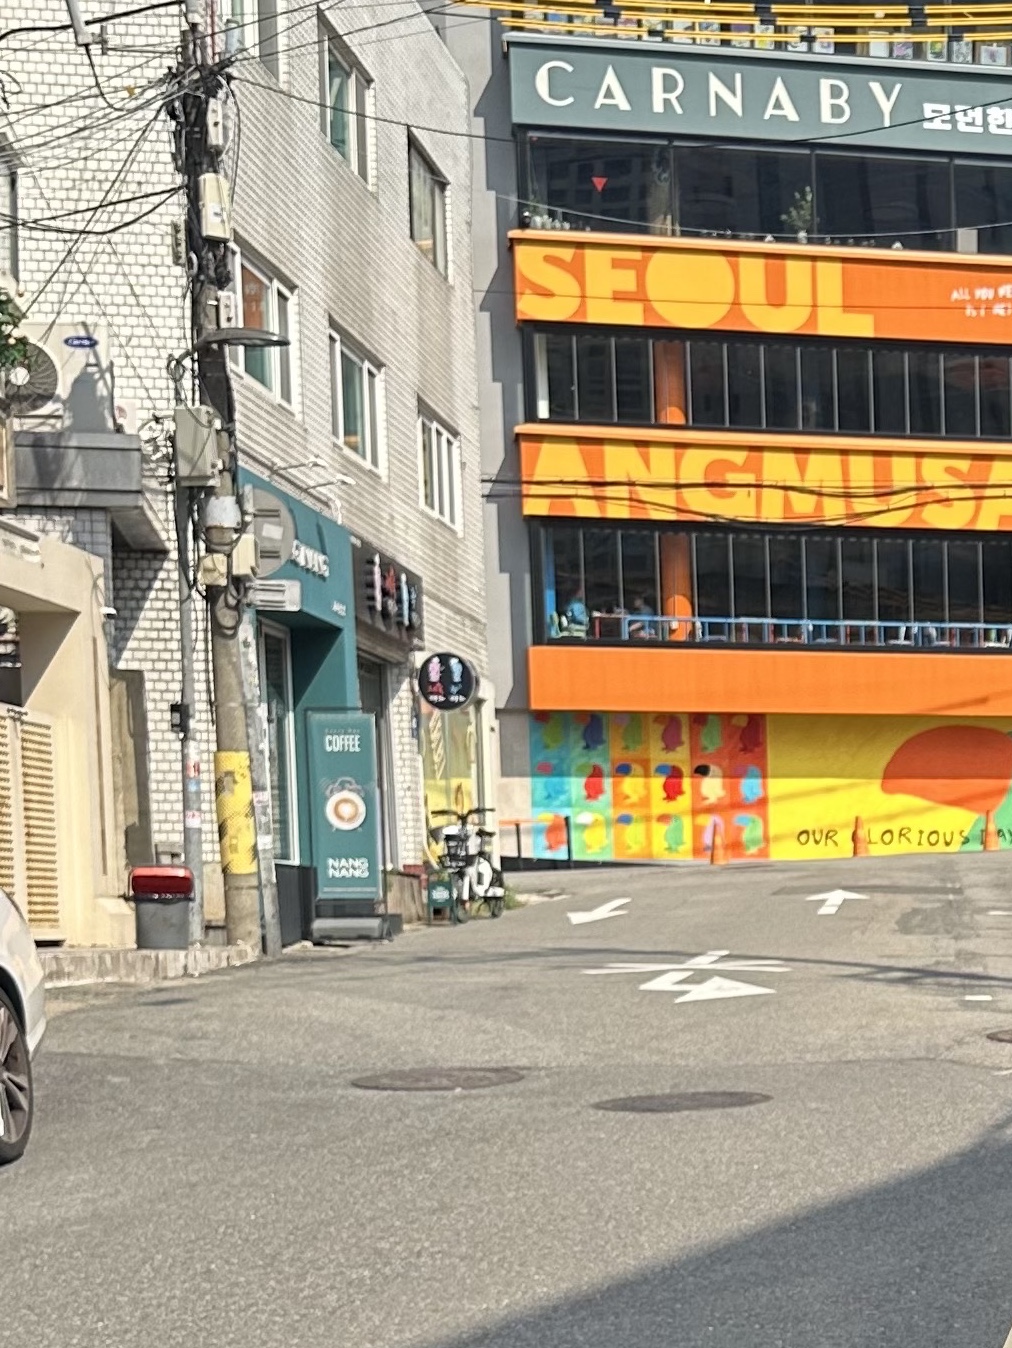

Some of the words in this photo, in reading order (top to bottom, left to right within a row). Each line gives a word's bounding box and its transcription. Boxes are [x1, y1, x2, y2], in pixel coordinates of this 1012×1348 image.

[535, 60, 902, 128] CARNABY
[518, 239, 875, 337] SEOUL
[325, 734, 361, 752] COFFEE
[797, 828, 839, 847] OUR
[852, 827, 970, 847] LORIOUS
